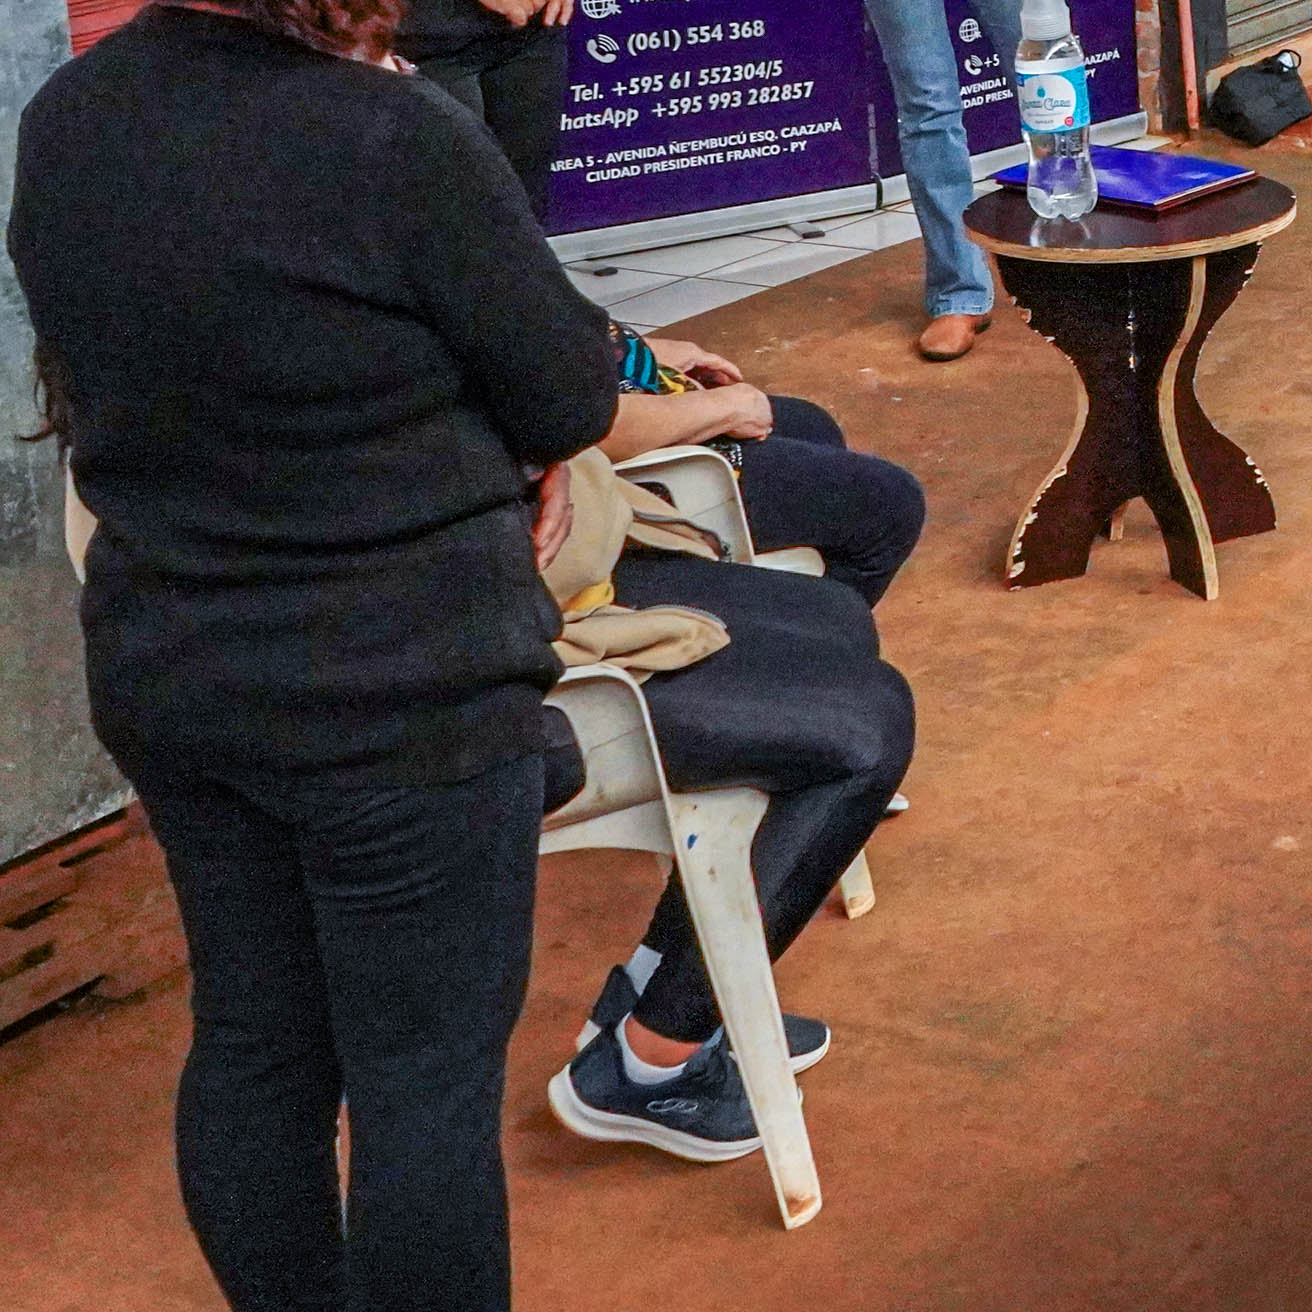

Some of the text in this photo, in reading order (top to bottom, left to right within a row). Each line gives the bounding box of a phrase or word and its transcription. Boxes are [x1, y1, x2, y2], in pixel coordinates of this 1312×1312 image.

[627, 20, 765, 56] (061) 554 368
[1084, 48, 1120, 65] AAZAPÁ
[570, 59, 783, 102] Tel. +595 61 552304/5
[960, 78, 1001, 96] AVENIDA
[560, 81, 814, 131] hatsApp +595 993 282857
[963, 96, 984, 109] DAD
[586, 156, 595, 167] 5
[605, 145, 666, 165] AVENIDA
[749, 129, 779, 144] ESQ.
[780, 118, 842, 139] CAAZAPÁ
[586, 165, 641, 183] CIUDAD
[643, 152, 724, 176] PRESIDENTE
[726, 144, 781, 162] FRANCO
[790, 140, 807, 154] PY
